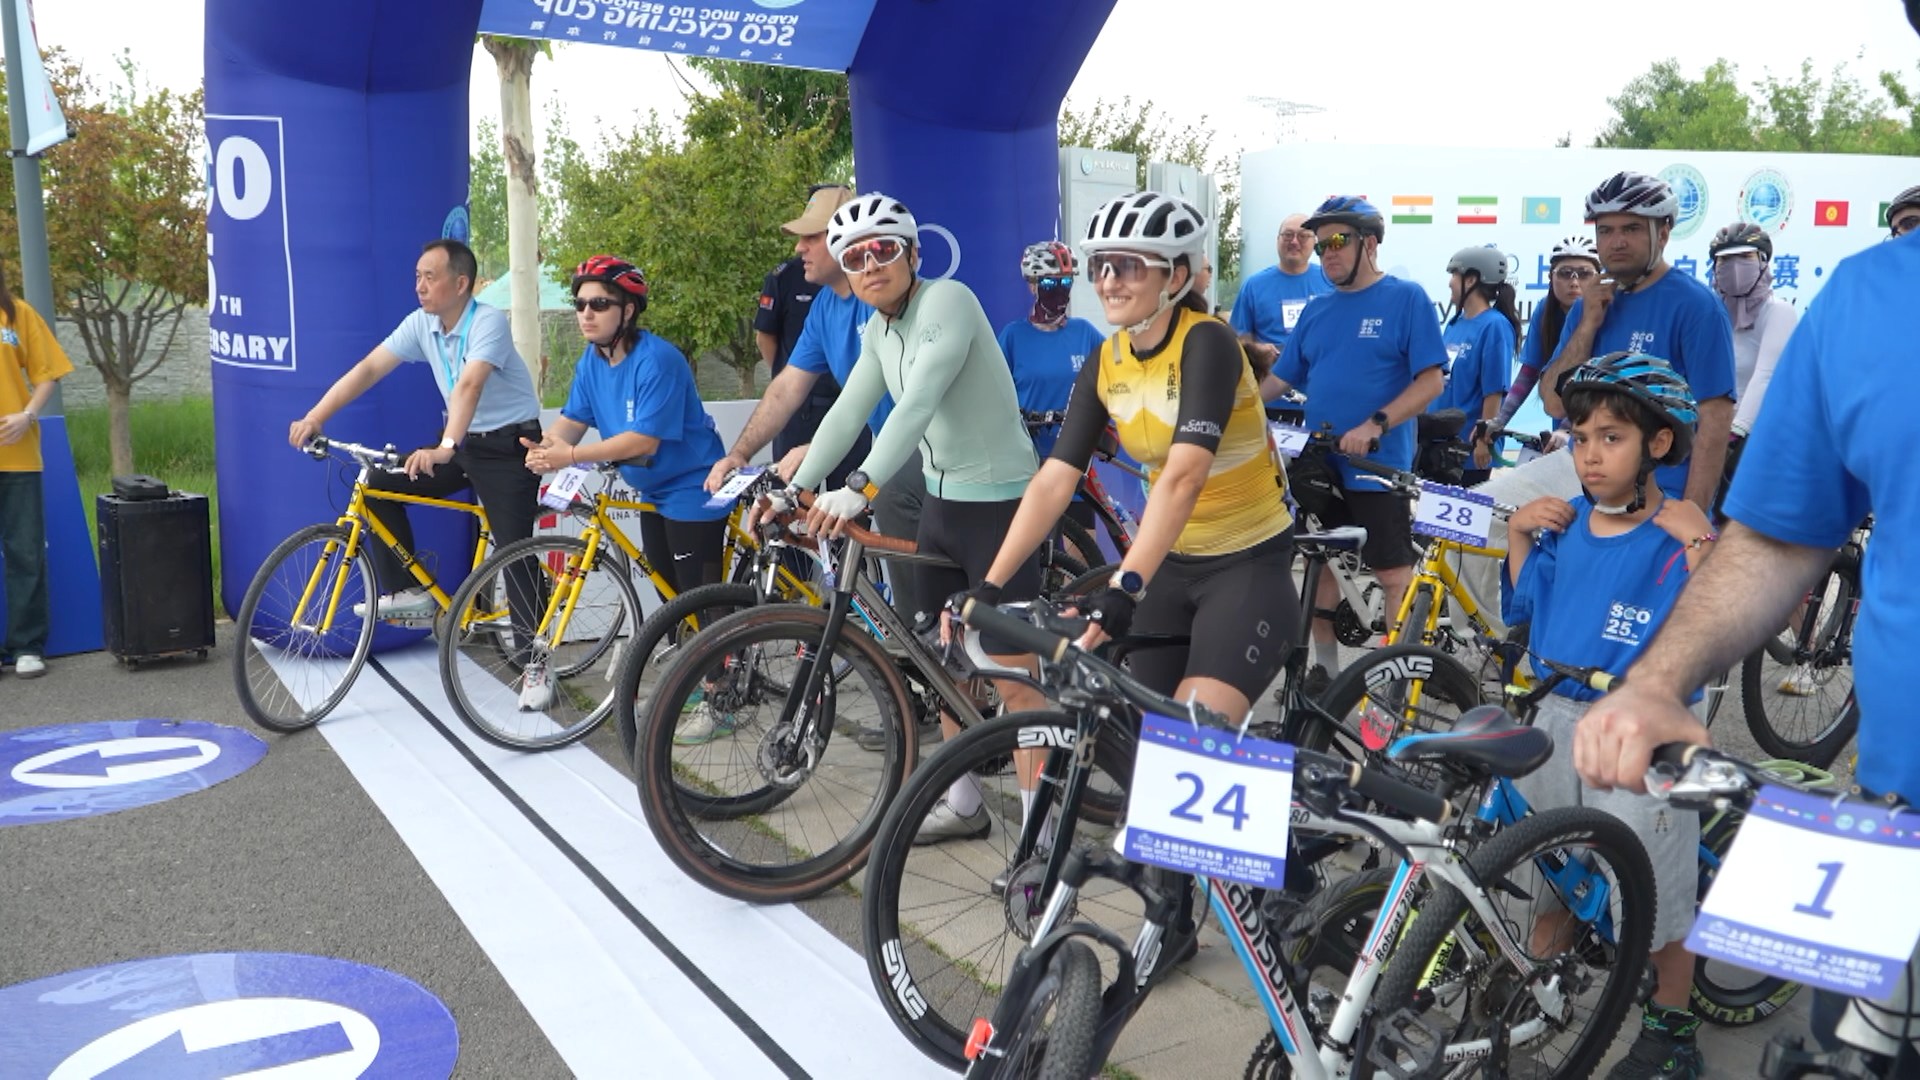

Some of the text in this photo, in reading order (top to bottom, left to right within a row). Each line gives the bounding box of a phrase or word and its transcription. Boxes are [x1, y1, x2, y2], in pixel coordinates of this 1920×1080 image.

[220, 294, 242, 316] TH
[1435, 501, 1473, 526] 28
[1611, 603, 1651, 624] SCO
[1170, 771, 1250, 831] 24
[1792, 861, 1845, 920] 1
[1375, 911, 1403, 962] Bobcat
